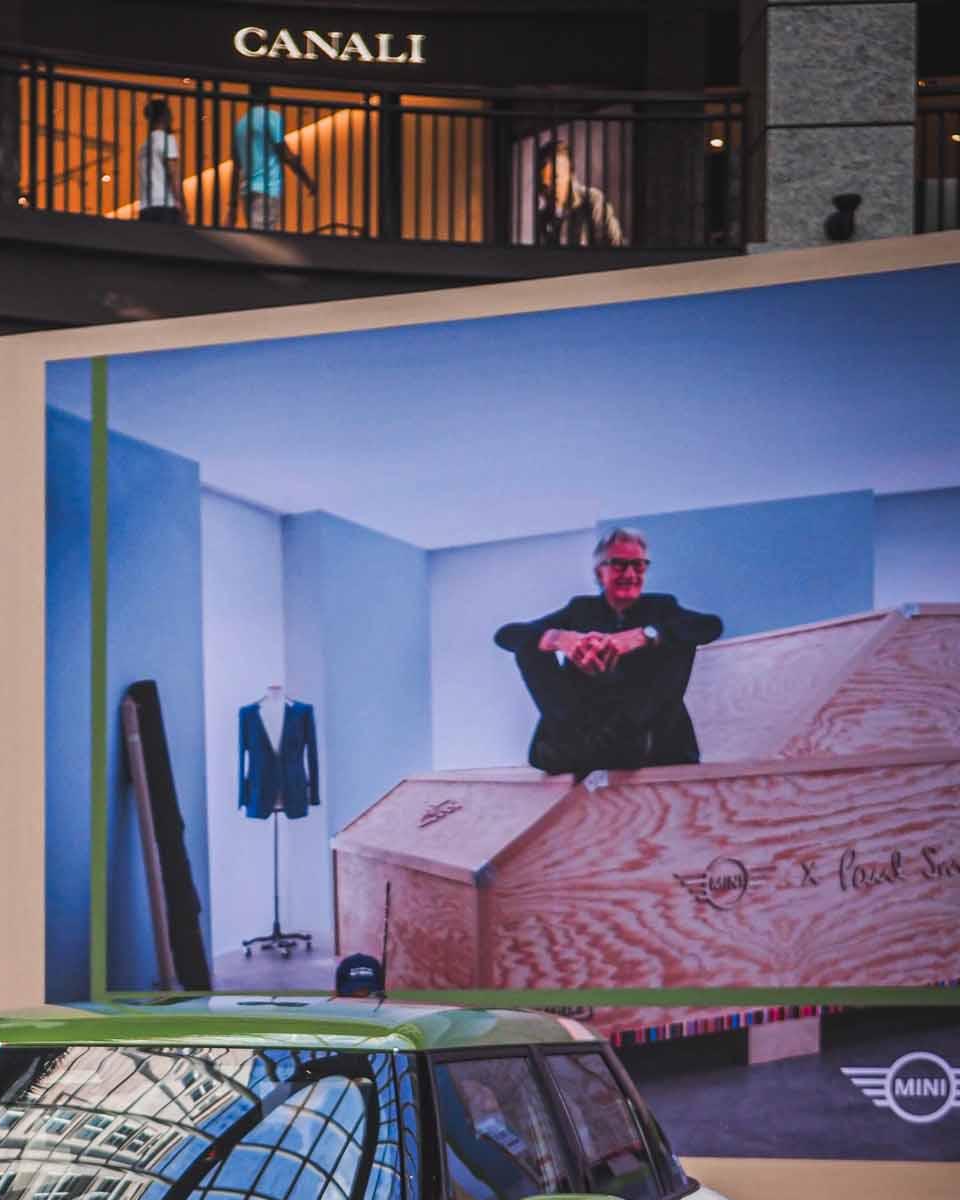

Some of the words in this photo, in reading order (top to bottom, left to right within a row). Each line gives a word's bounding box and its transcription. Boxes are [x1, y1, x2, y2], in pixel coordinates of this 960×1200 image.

[233, 26, 427, 63] CANALI
[840, 849, 901, 892] Paul
[894, 1078, 947, 1097] MINI
